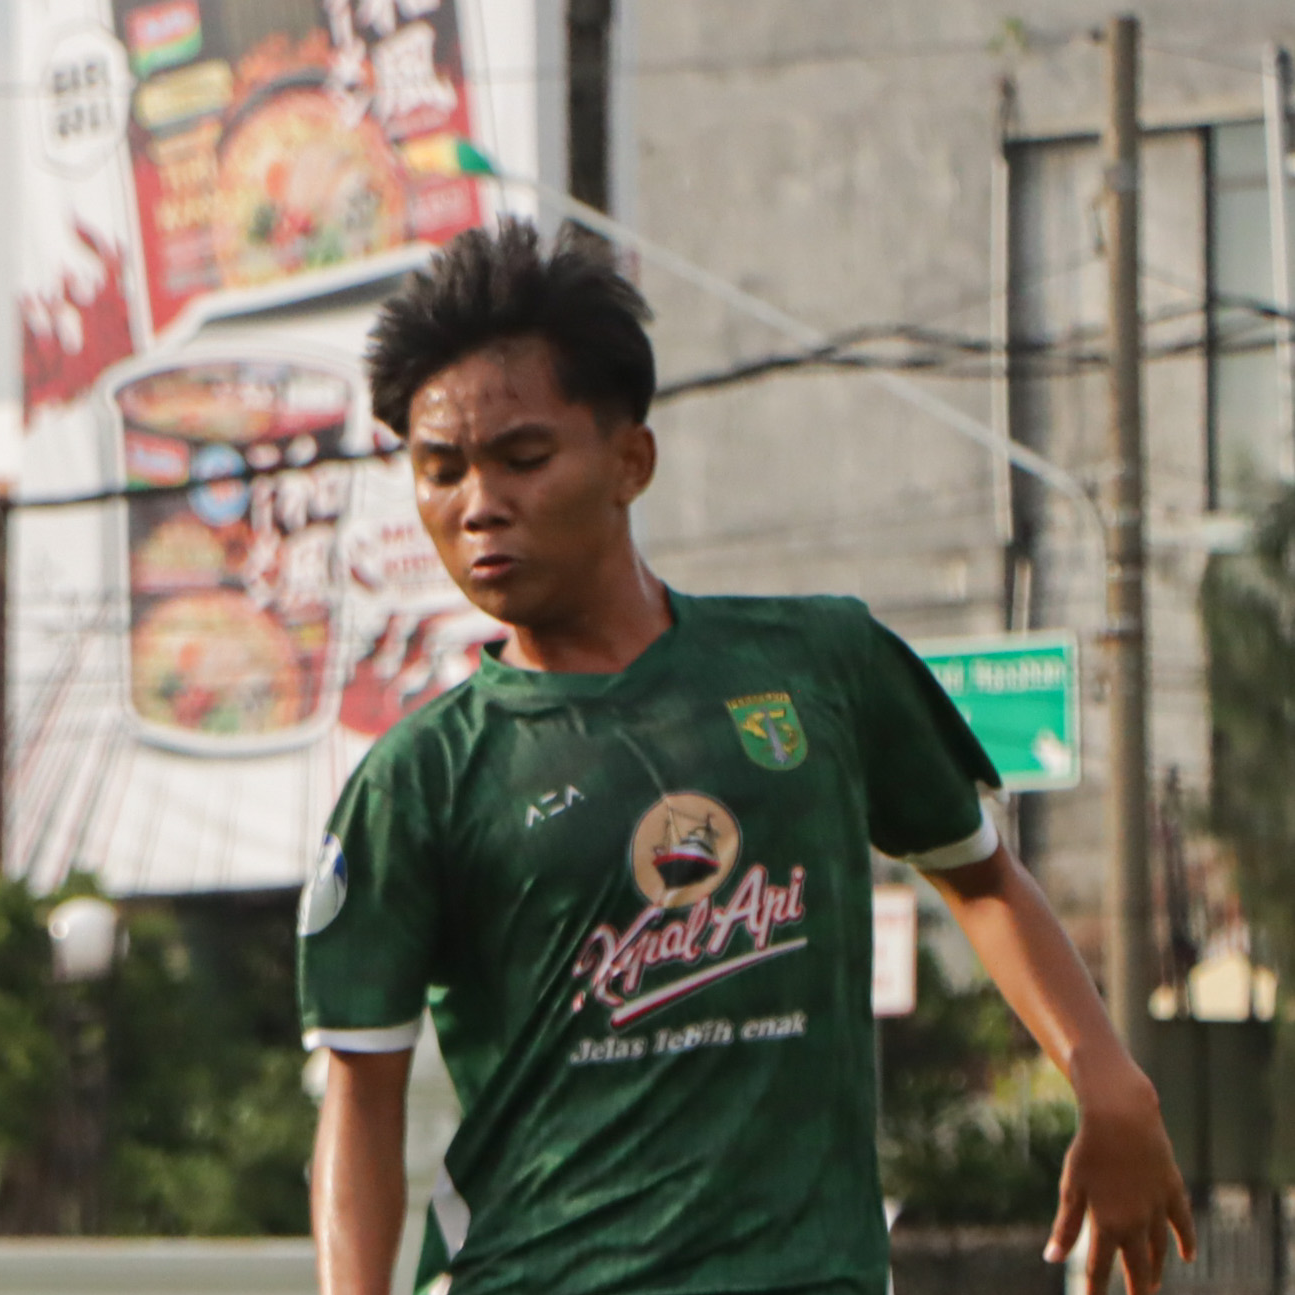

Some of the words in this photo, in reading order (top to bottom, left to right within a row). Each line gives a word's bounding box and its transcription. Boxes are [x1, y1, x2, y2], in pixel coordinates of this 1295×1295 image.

[707, 863, 808, 952] Api
[569, 1037, 647, 1064] Jelas
[653, 1018, 734, 1053] lebih
[740, 1009, 808, 1041] enak
